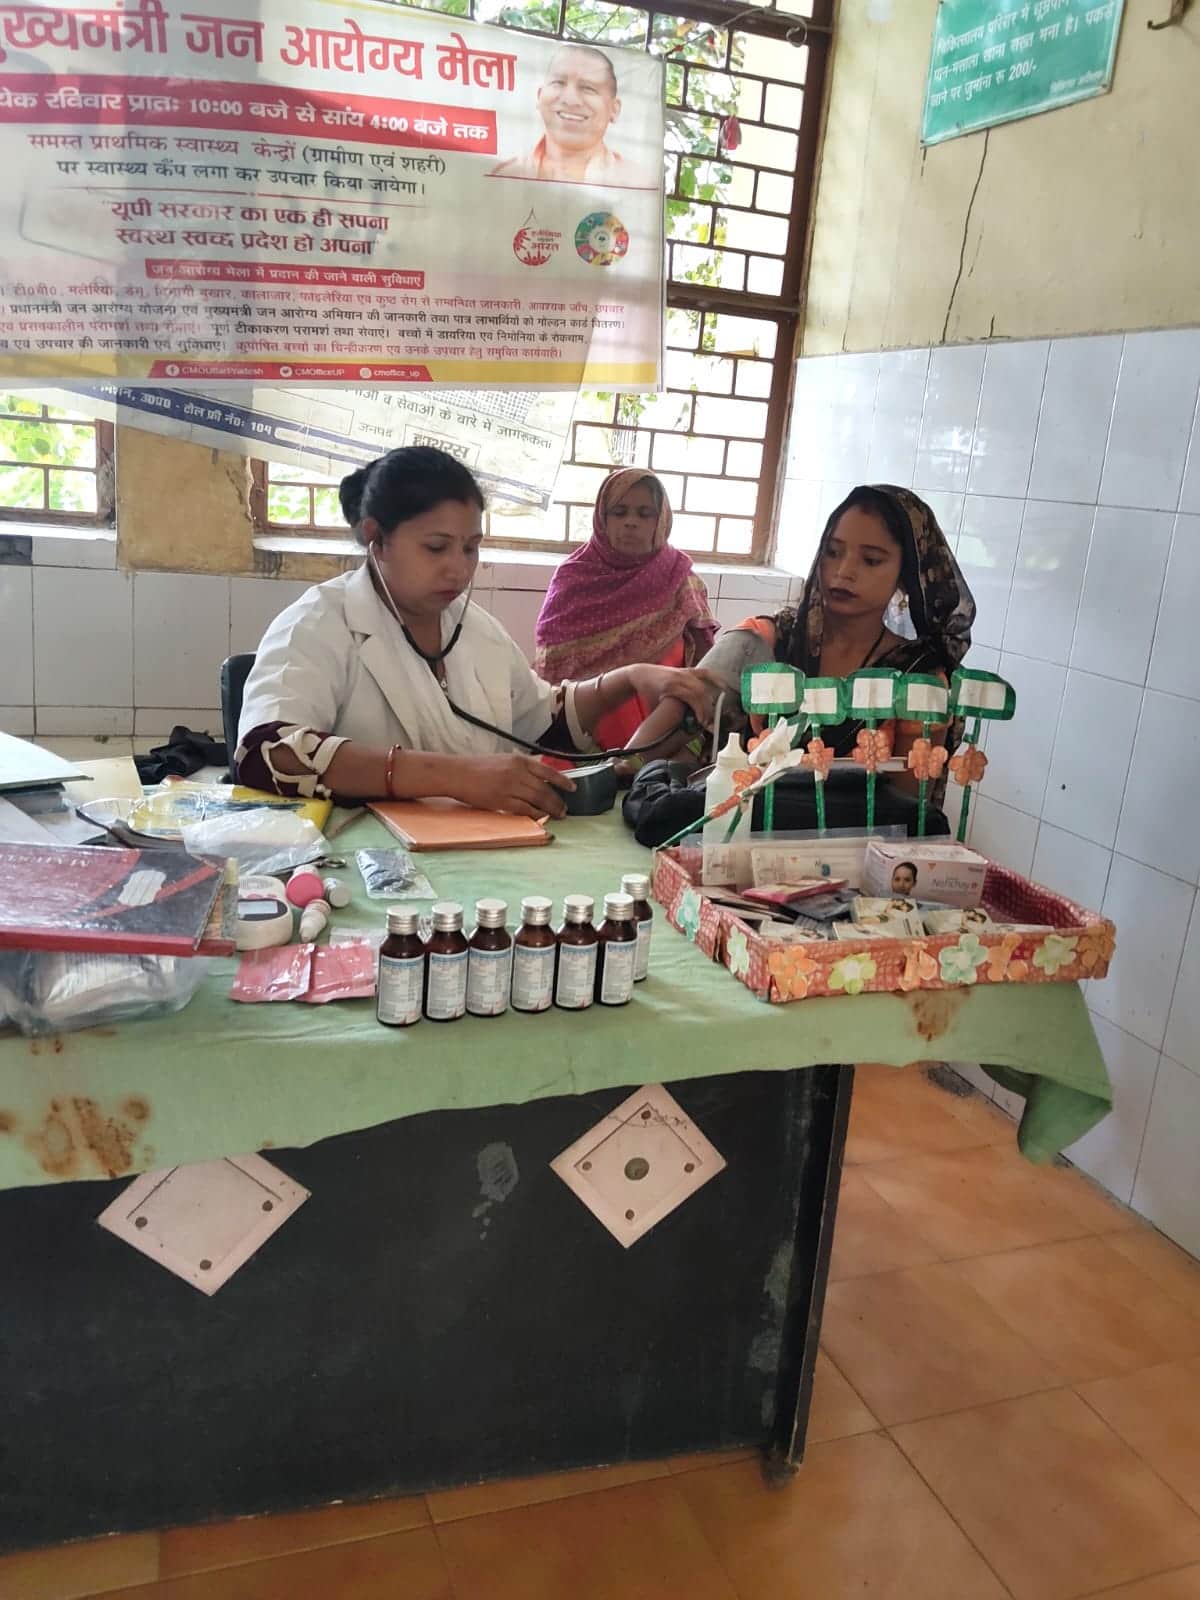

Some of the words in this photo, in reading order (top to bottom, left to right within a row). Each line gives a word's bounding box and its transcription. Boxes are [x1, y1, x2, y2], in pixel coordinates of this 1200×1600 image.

[181, 12, 265, 63] जन
[280, 18, 424, 80] आरोग्य
[436, 32, 518, 91] मेला
[45, 86, 122, 110] रविवार
[190, 98, 243, 116] 10:00
[249, 100, 288, 120] बजे
[295, 102, 317, 125] से
[370, 114, 409, 133] 4:00
[413, 116, 448, 138] बजे
[452, 122, 489, 141] तक
[27, 132, 83, 150] समस्त
[89, 131, 168, 151] प्राथमिक
[174, 136, 238, 155] स्वास्थ्य
[251, 137, 296, 162] केन्द्रों
[302, 144, 363, 166] (ग्रामीण
[370, 150, 394, 173] एवं
[400, 153, 447, 175] शहरी)
[57, 160, 80, 174] पर
[87, 160, 148, 177] स्वास्थ्य
[193, 164, 228, 180] लगा
[235, 167, 260, 182] कर
[267, 170, 317, 188] उपचार
[323, 172, 363, 192] किया
[158, 202, 235, 222] सरकार
[240, 206, 267, 223] का
[273, 208, 306, 226] एक
[311, 207, 333, 228] ही
[338, 213, 389, 231] सपना
[115, 228, 175, 246] स्वस्थ
[241, 231, 288, 252] प्रदेश
[293, 233, 314, 253] हो
[303, 267, 319, 281] की
[323, 269, 348, 282] जाने
[351, 271, 377, 284] वाली
[256, 307, 276, 318] जन
[322, 307, 362, 321] अभियान
[366, 308, 380, 321] की
[384, 310, 427, 323] जानकारी
[430, 314, 450, 324] तथा
[453, 314, 472, 325] पात्र
[36, 339, 74, 350] उपचार
[78, 336, 93, 349] की
[97, 336, 149, 350] जानकारी
[235, 321, 289, 336] टीकाकरण
[333, 327, 354, 337] तथा
[437, 328, 475, 341] डायरिया
[497, 328, 535, 342] निमोनिया
[184, 402, 205, 417] टोल
[251, 421, 272, 436] 104
[439, 407, 452, 421] के
[457, 412, 477, 429] बारे
[482, 417, 493, 433] में
